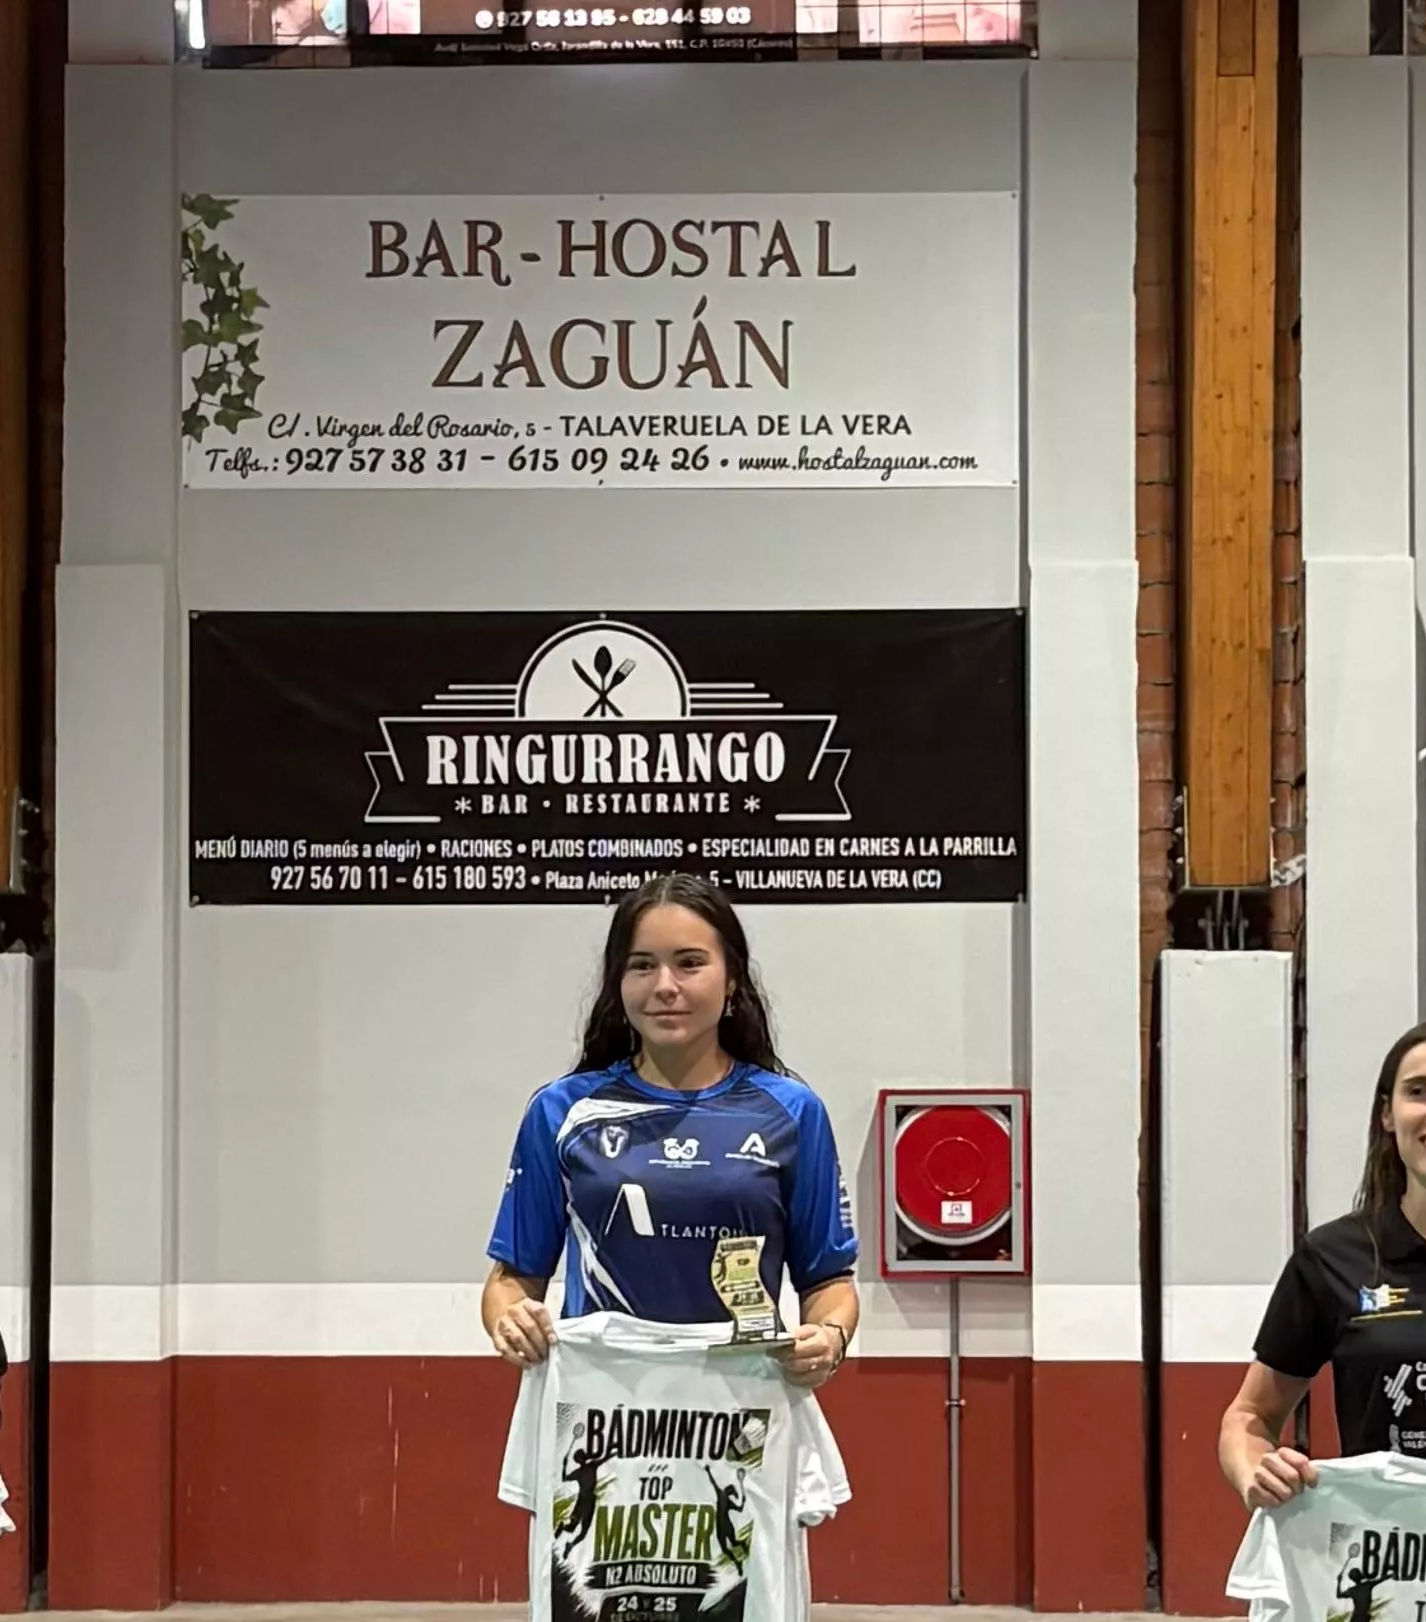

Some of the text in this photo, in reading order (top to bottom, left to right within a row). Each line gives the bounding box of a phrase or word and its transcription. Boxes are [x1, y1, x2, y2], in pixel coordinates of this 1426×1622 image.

[432, 295, 794, 390] ZAGUÁN
[315, 415, 382, 448] Virgen
[389, 412, 422, 440] del
[425, 413, 519, 443] Rosario,
[561, 414, 748, 438] TALAVERUELA
[758, 414, 794, 437] DE
[801, 414, 834, 437] LA
[841, 413, 912, 437] VERA
[285, 448, 344, 475] 927
[348, 447, 382, 475] 57
[390, 447, 426, 475] 38
[436, 447, 467, 474] 31
[507, 446, 561, 474] 615
[571, 446, 607, 475] 09
[620, 446, 660, 473] 24
[671, 446, 709, 473] 26
[737, 447, 979, 482] www.hostalzaguan.com
[426, 732, 785, 787] RINGURRANGO
[481, 793, 731, 815] BAR RESTAURANTE
[195, 836, 1016, 864] MENÚ DIARIO (5 menús a elegir) RACIONES PLATOS COMBINADOS ESPECIALIDAD EN CARNES A LA PARRILLA
[270, 866, 306, 891] 927
[310, 866, 335, 891] 56
[340, 866, 365, 890] 70
[370, 866, 388, 890] 11
[412, 866, 449, 890] 615
[454, 866, 490, 890] 180
[494, 866, 526, 890] 593
[545, 870, 583, 890] Plaza
[587, 870, 640, 890] Aniceto
[736, 869, 825, 889] VILLANUEVA
[829, 868, 847, 888] DE
[851, 868, 868, 888] LA
[872, 868, 908, 888] VERA
[913, 868, 941, 889] (CC)
[639, 1477, 673, 1500] TOP
[593, 1504, 716, 1561] MASTER
[606, 1564, 696, 1585] N2 ABSOLUTO
[618, 1597, 677, 1612] 24 25
